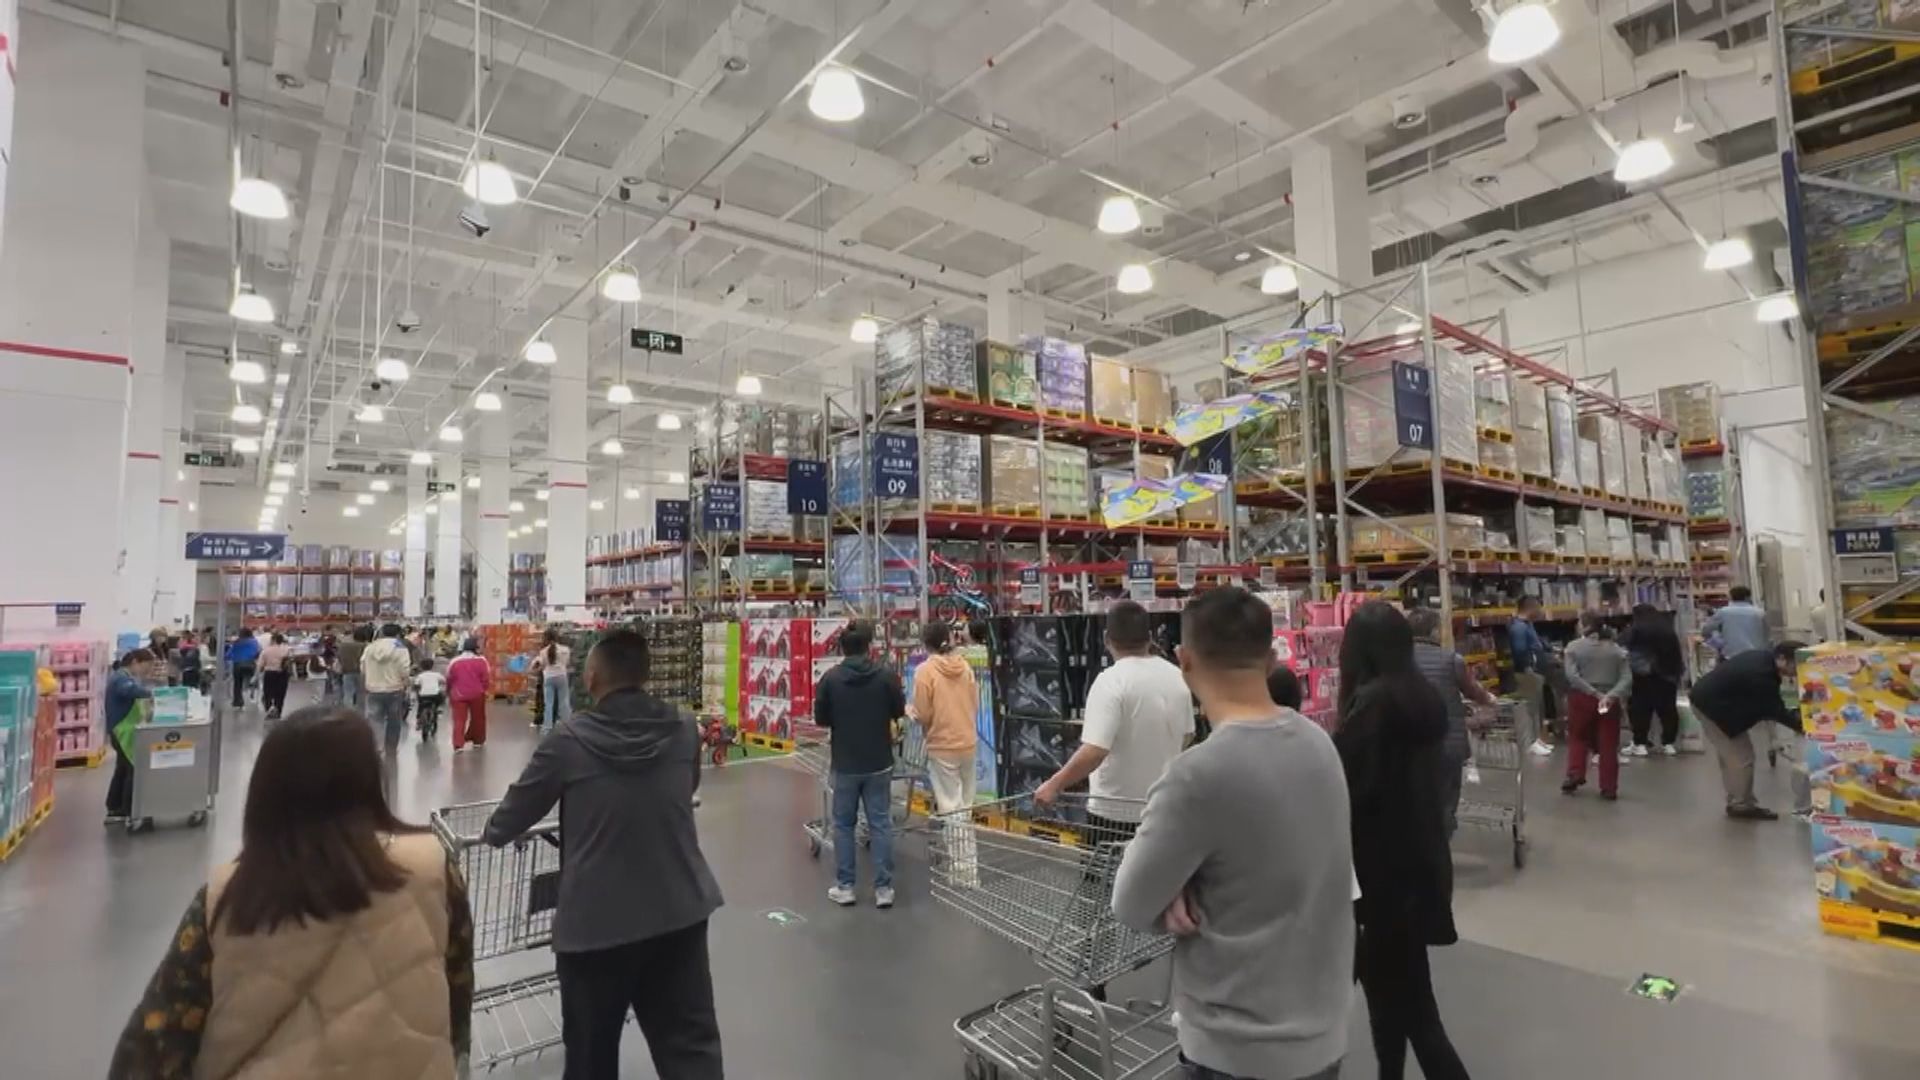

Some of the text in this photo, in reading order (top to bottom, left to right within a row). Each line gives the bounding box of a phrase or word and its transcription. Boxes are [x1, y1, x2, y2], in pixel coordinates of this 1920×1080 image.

[1409, 423, 1423, 442] 07
[1208, 457, 1222, 474] 08
[888, 478, 907, 495] 09
[801, 497, 817, 512] 10
[715, 517, 729, 529] 11
[667, 529, 681, 540] 12
